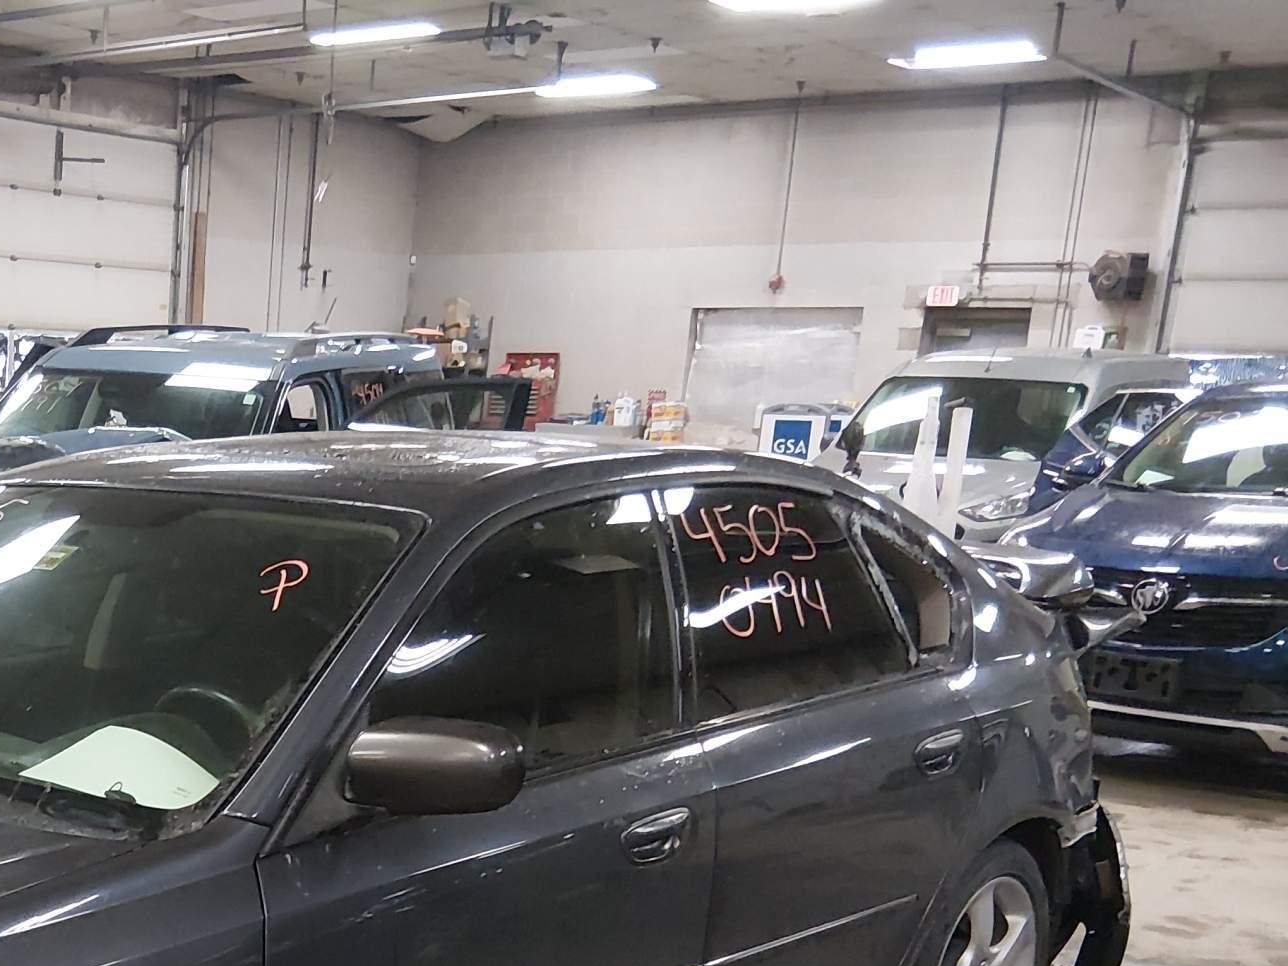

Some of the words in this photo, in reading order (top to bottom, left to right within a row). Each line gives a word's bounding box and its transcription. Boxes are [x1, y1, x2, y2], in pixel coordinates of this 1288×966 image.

[773, 438, 807, 455] GSA
[680, 502, 817, 563] 4505
[259, 559, 310, 612] P
[719, 570, 832, 638] 0494
